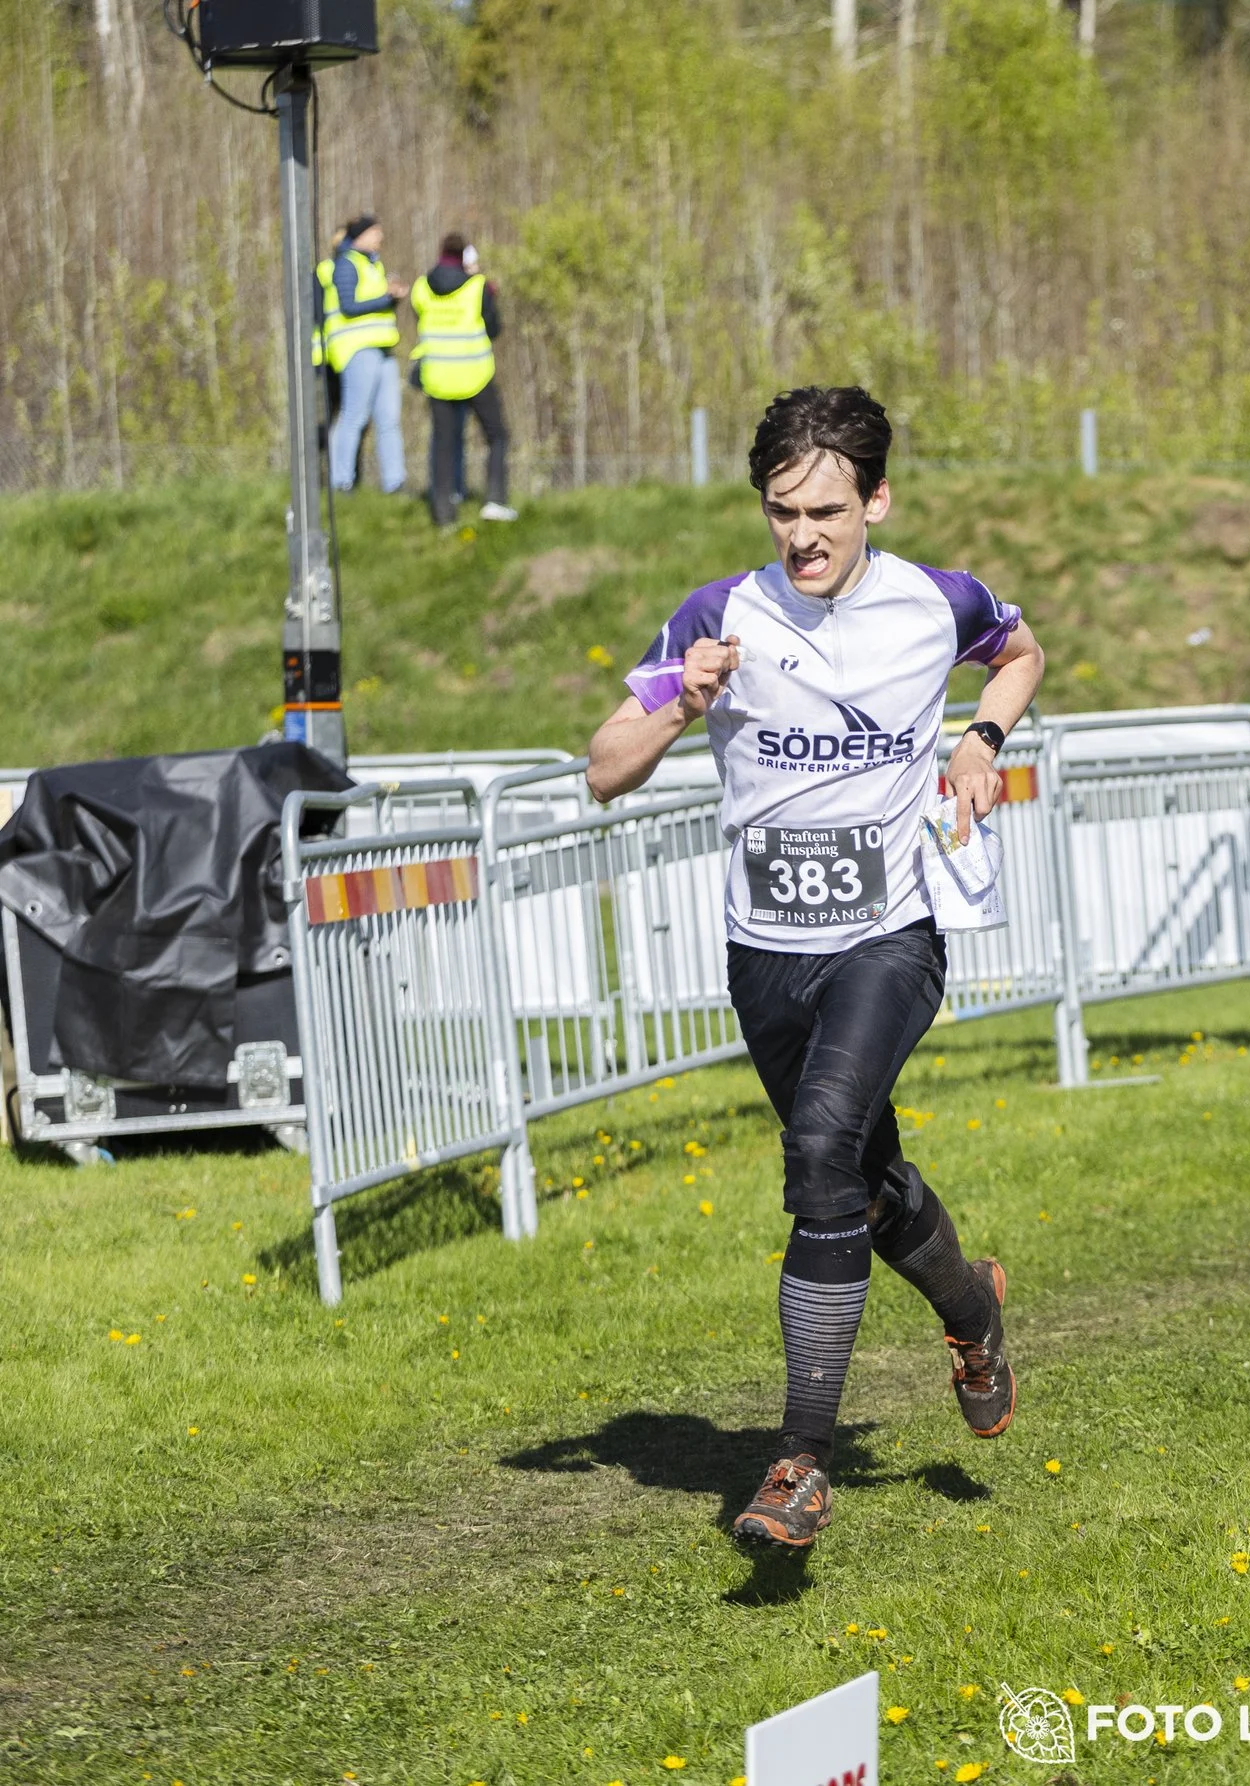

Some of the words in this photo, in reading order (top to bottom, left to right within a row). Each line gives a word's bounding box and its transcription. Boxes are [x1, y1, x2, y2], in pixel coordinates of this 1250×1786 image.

[757, 727, 916, 762] SÖDERS
[757, 756, 850, 773] ORIENTERING
[780, 830, 828, 843] Kraften
[832, 829, 837, 841] i
[849, 825, 882, 851] 10
[780, 843, 839, 859] Finspång
[768, 858, 863, 905] 383
[777, 908, 868, 924] FINSPÅNG
